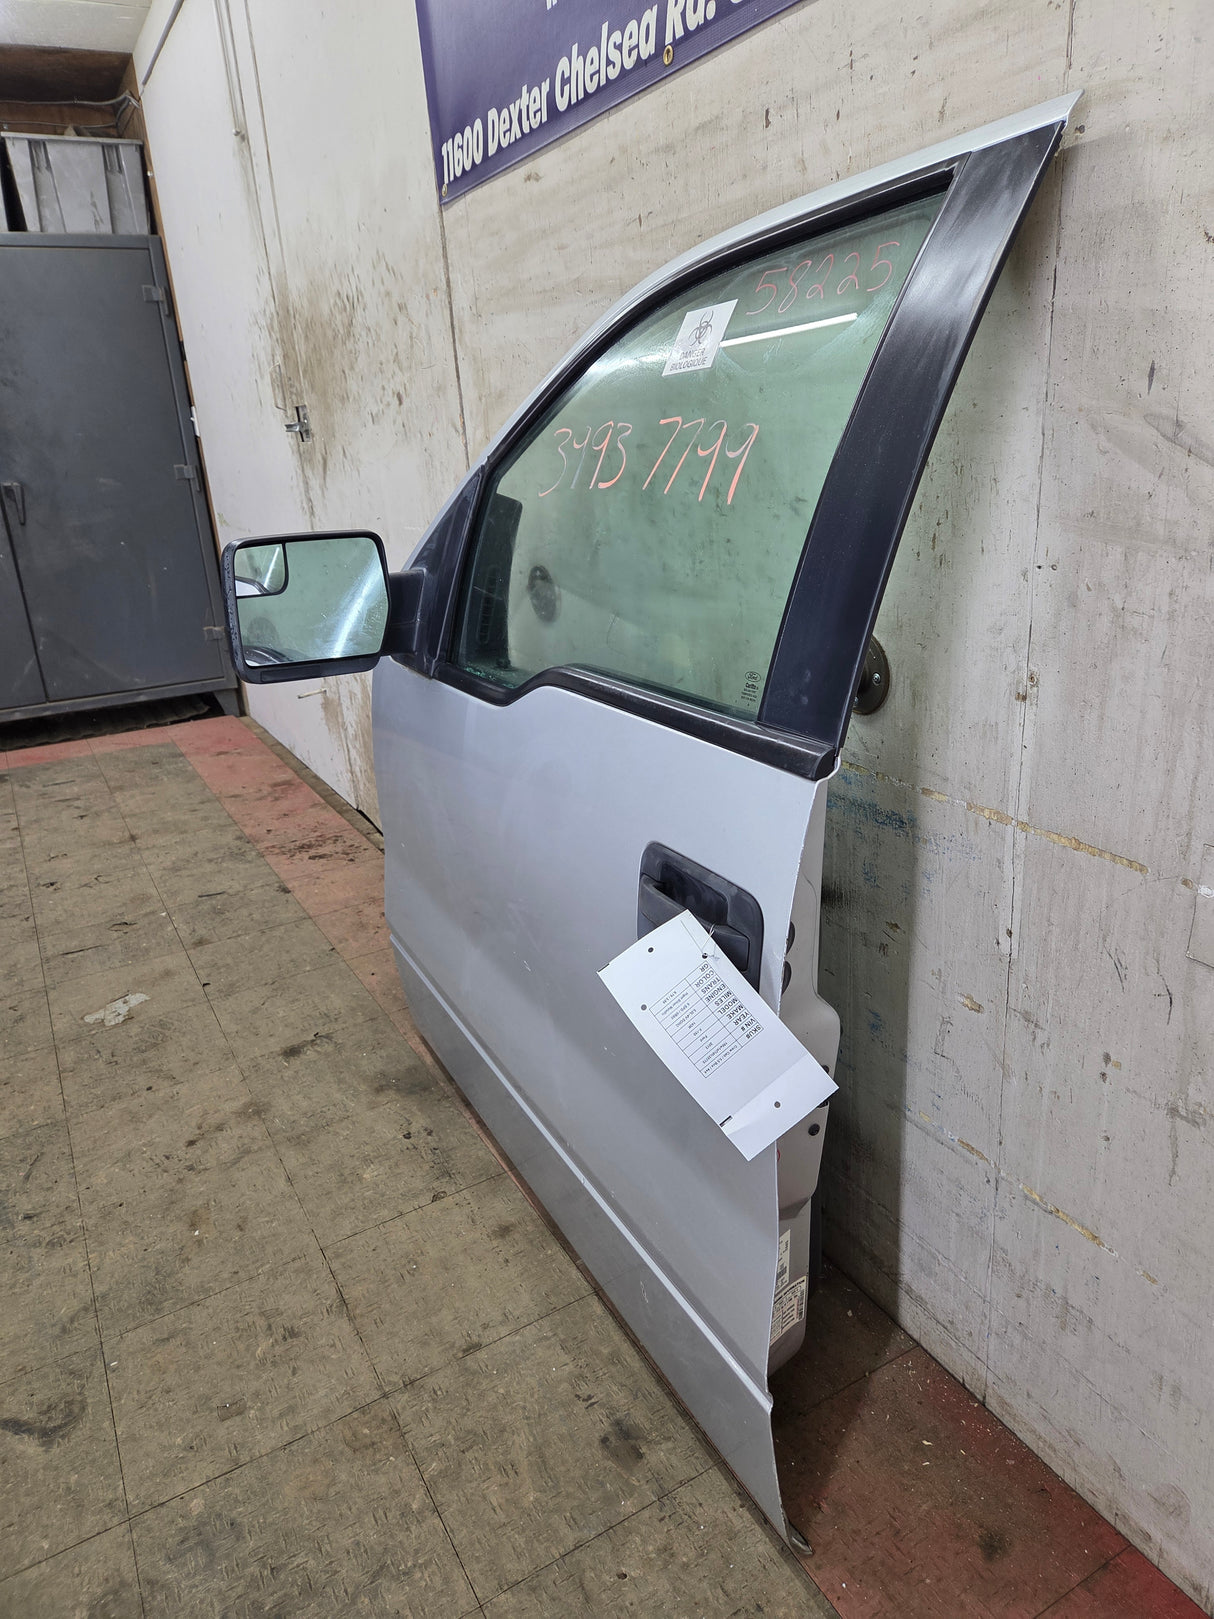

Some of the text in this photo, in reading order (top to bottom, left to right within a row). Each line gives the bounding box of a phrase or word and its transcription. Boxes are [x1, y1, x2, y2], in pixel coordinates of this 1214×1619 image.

[441, 118, 483, 184] 11600
[487, 77, 550, 157] Dexter
[555, 5, 658, 112] Chelsea
[745, 241, 900, 315] 58225
[679, 347, 706, 361] DANGER
[669, 356, 708, 372] BIOLOGIQUE
[642, 416, 759, 505] 7799
[698, 962, 709, 972] GR
[694, 969, 714, 988] COLOR
[700, 976, 720, 994] TRANS
[704, 982, 726, 1003] ENGINE
[713, 989, 732, 1006] MILES
[717, 996, 738, 1015] MODEL
[725, 1003, 743, 1020] MAKE
[732, 1010, 749, 1025] YEAR
[744, 1017, 755, 1028] VIN
